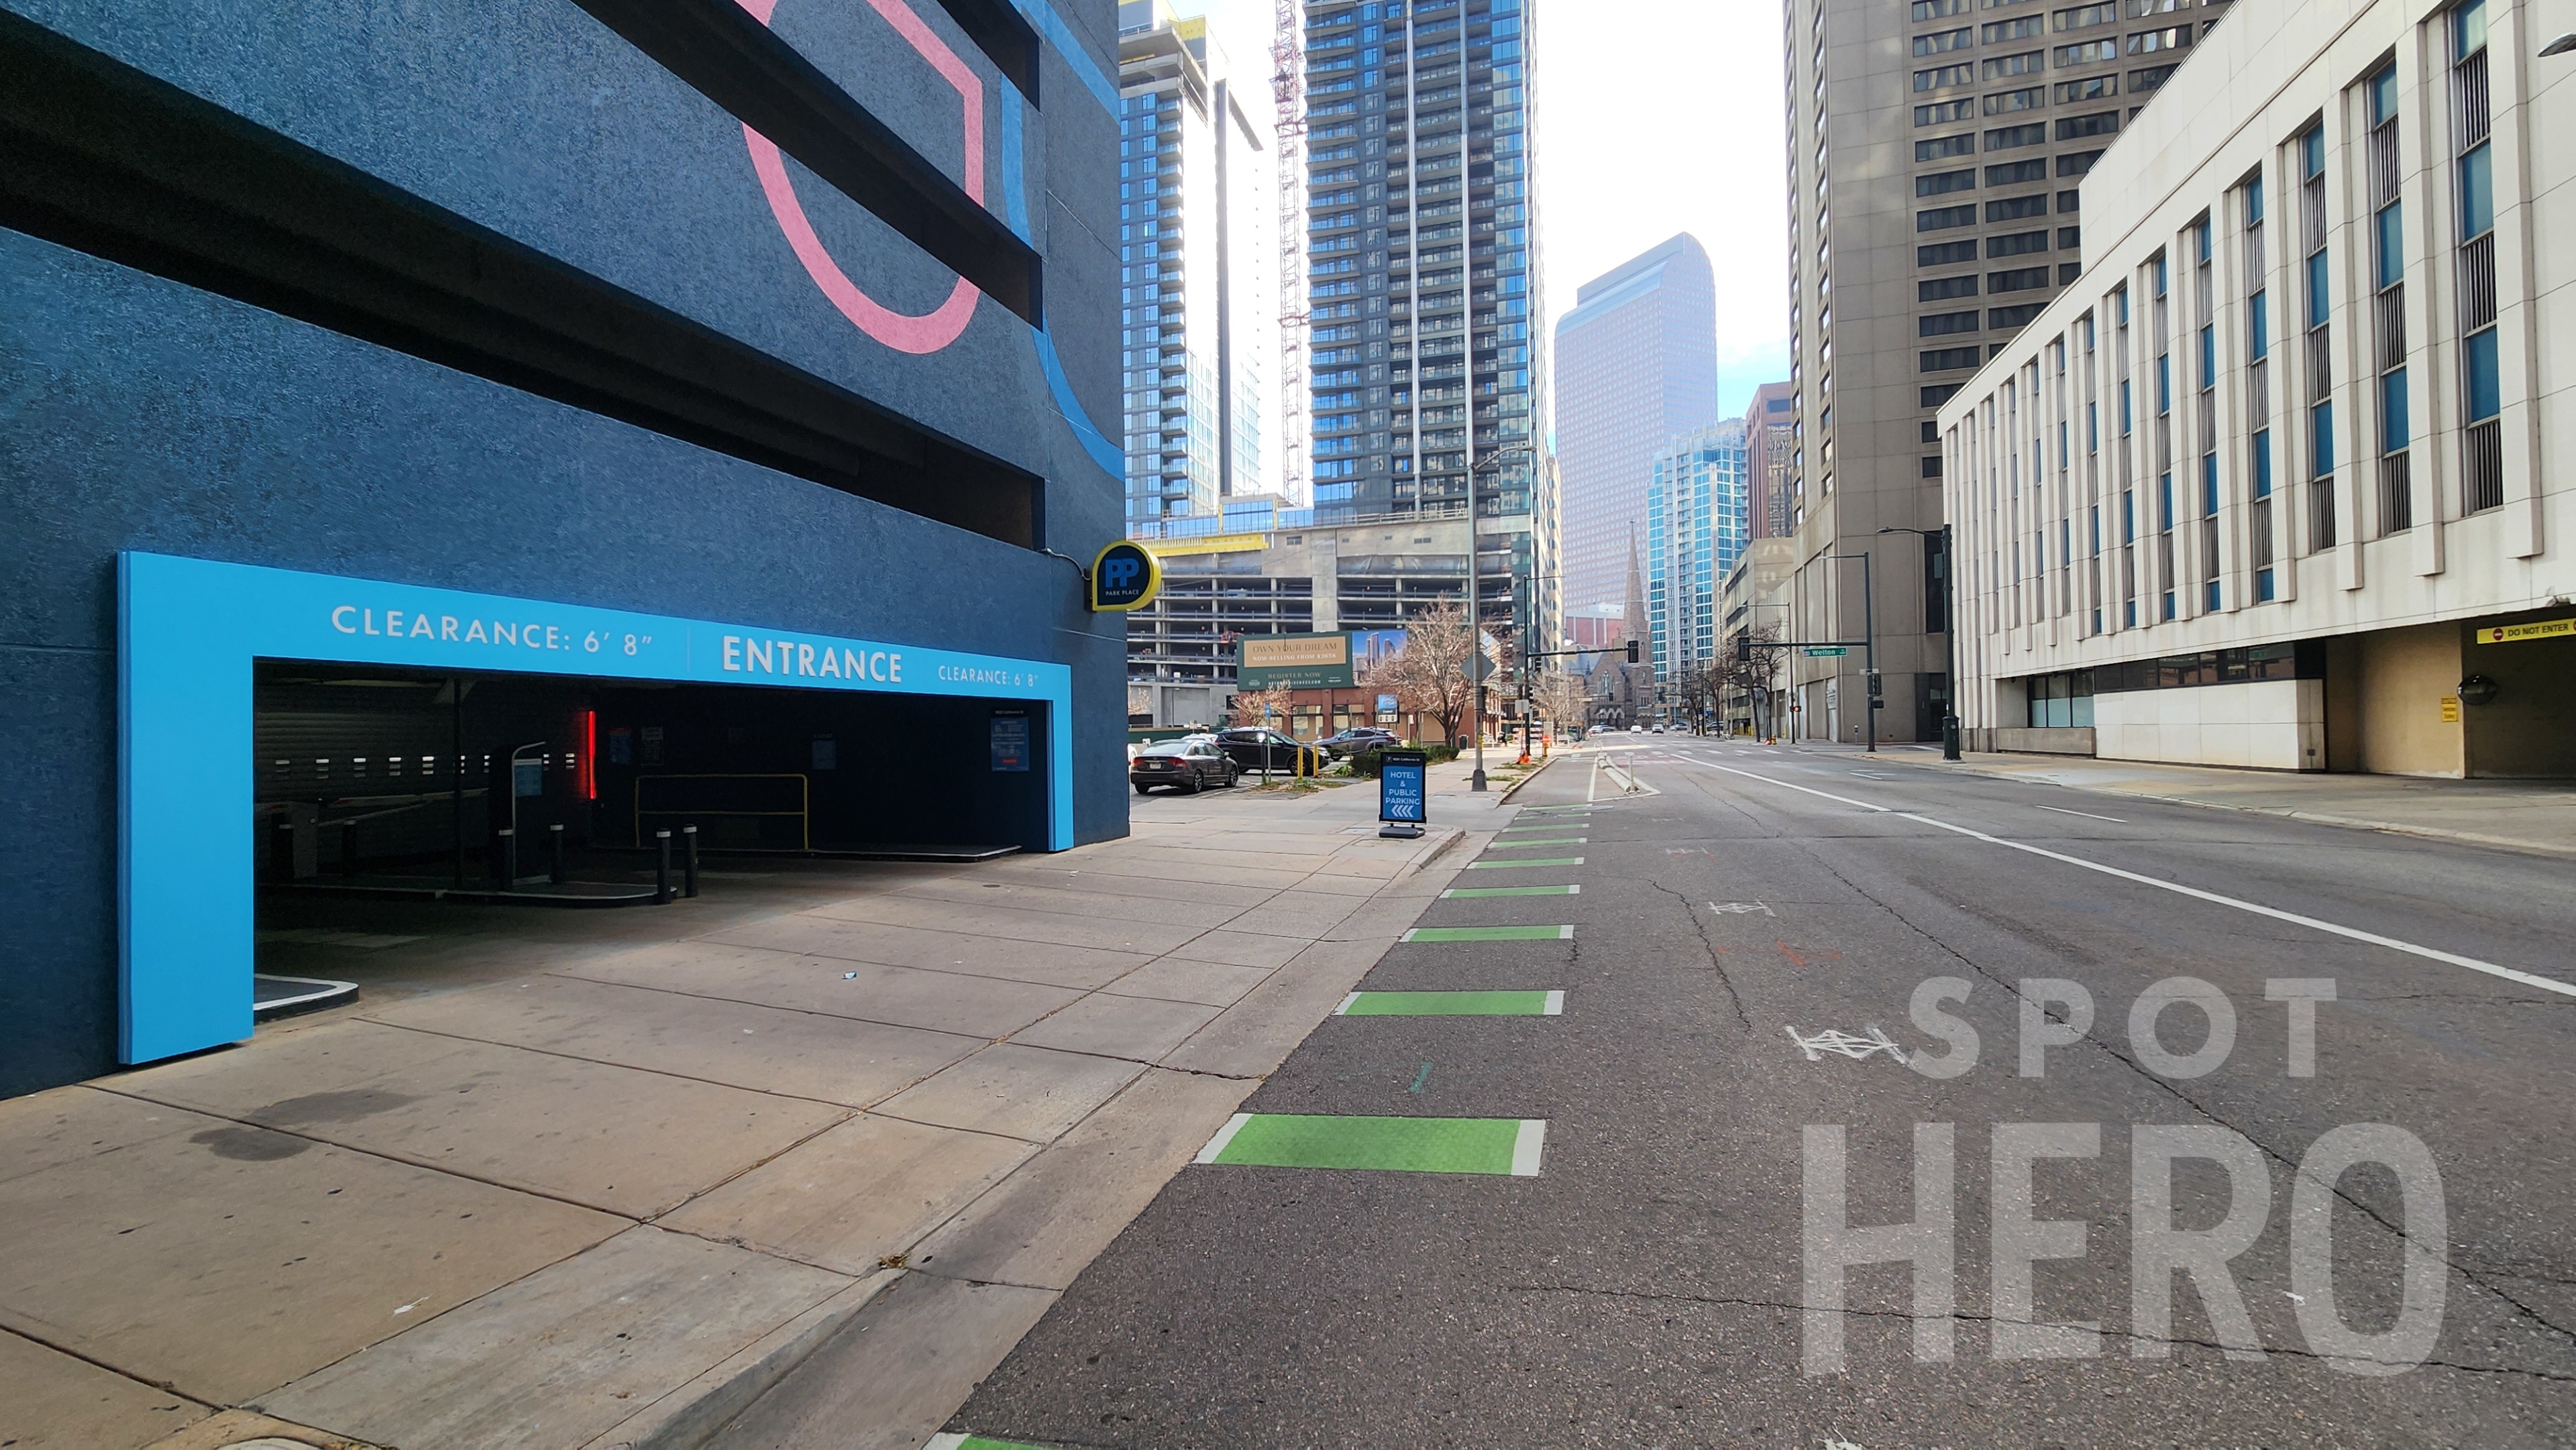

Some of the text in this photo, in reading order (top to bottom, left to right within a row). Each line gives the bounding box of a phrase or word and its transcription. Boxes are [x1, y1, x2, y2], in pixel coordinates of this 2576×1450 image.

[1105, 558, 1139, 588] PP
[331, 606, 570, 651] CLEARANCE:
[2523, 626, 2539, 634] NOT
[2542, 623, 2569, 633] ENTER
[723, 635, 902, 683] ENTRANCE
[1305, 643, 1337, 651] DREAM
[938, 665, 1010, 685] CLEARANCE:
